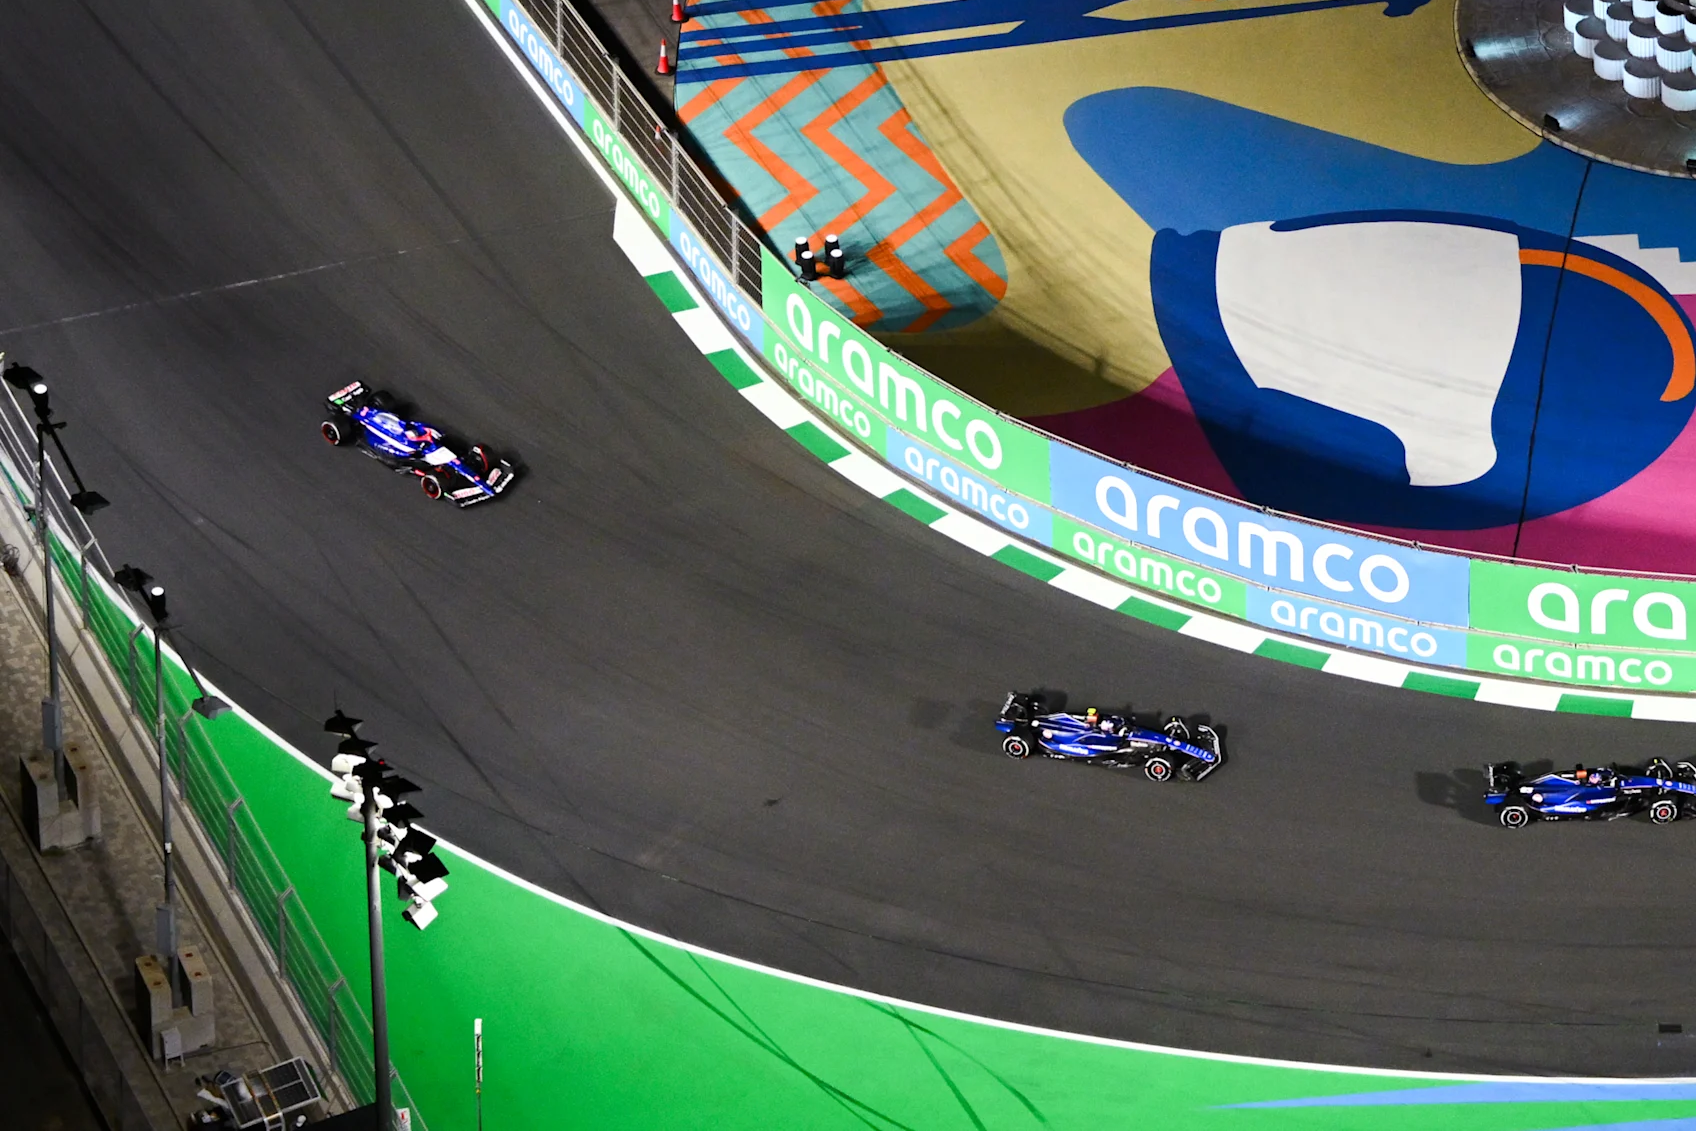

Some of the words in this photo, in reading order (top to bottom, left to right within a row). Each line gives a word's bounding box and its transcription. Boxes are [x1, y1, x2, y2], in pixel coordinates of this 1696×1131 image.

[508, 8, 574, 107] aramco
[592, 118, 661, 221] aramco
[680, 231, 751, 332] aramco
[773, 342, 872, 439] aramco
[786, 292, 1004, 471] aramco
[904, 446, 1030, 530] aramco
[1072, 531, 1223, 604] aramco
[1095, 475, 1411, 604] aramco
[1270, 599, 1438, 658] aramco
[1492, 643, 1673, 686] aramco
